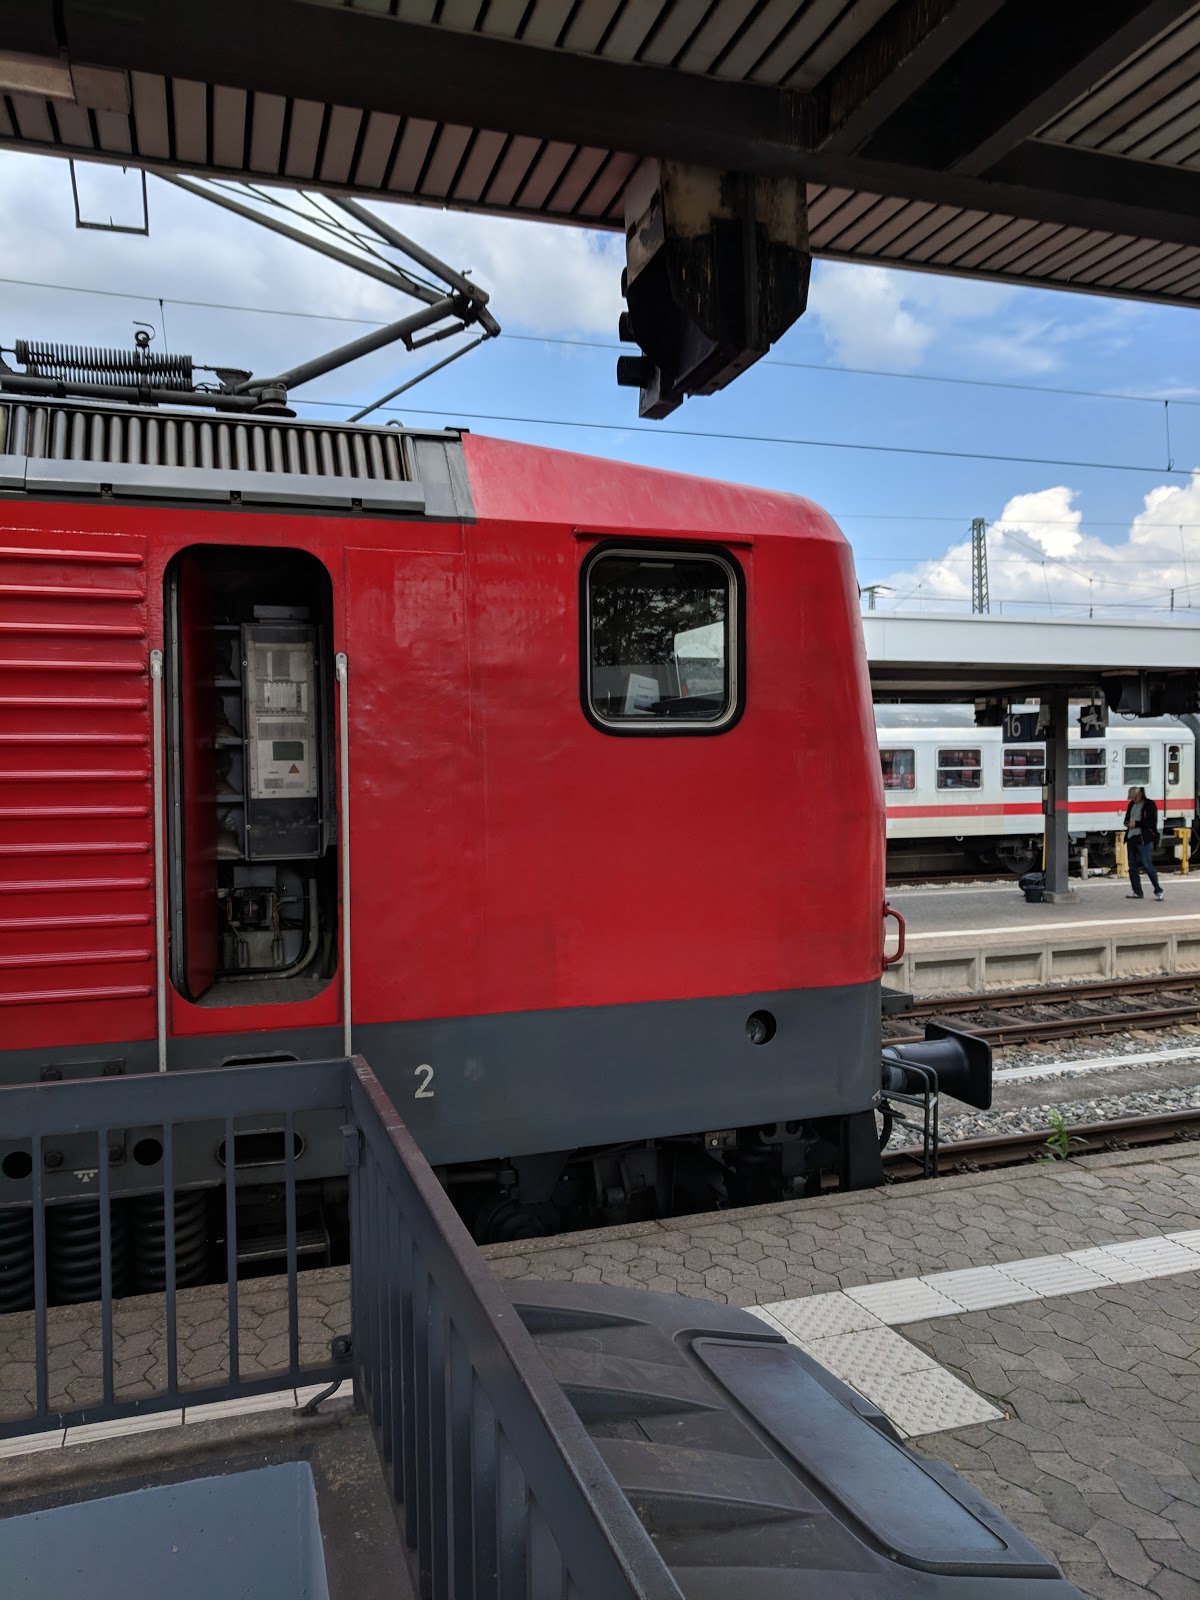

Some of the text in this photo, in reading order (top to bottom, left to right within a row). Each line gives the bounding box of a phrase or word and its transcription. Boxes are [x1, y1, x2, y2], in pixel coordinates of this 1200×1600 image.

[1004, 715, 1021, 737] 16
[1112, 750, 1119, 763] 2
[414, 1063, 435, 1099] 2
